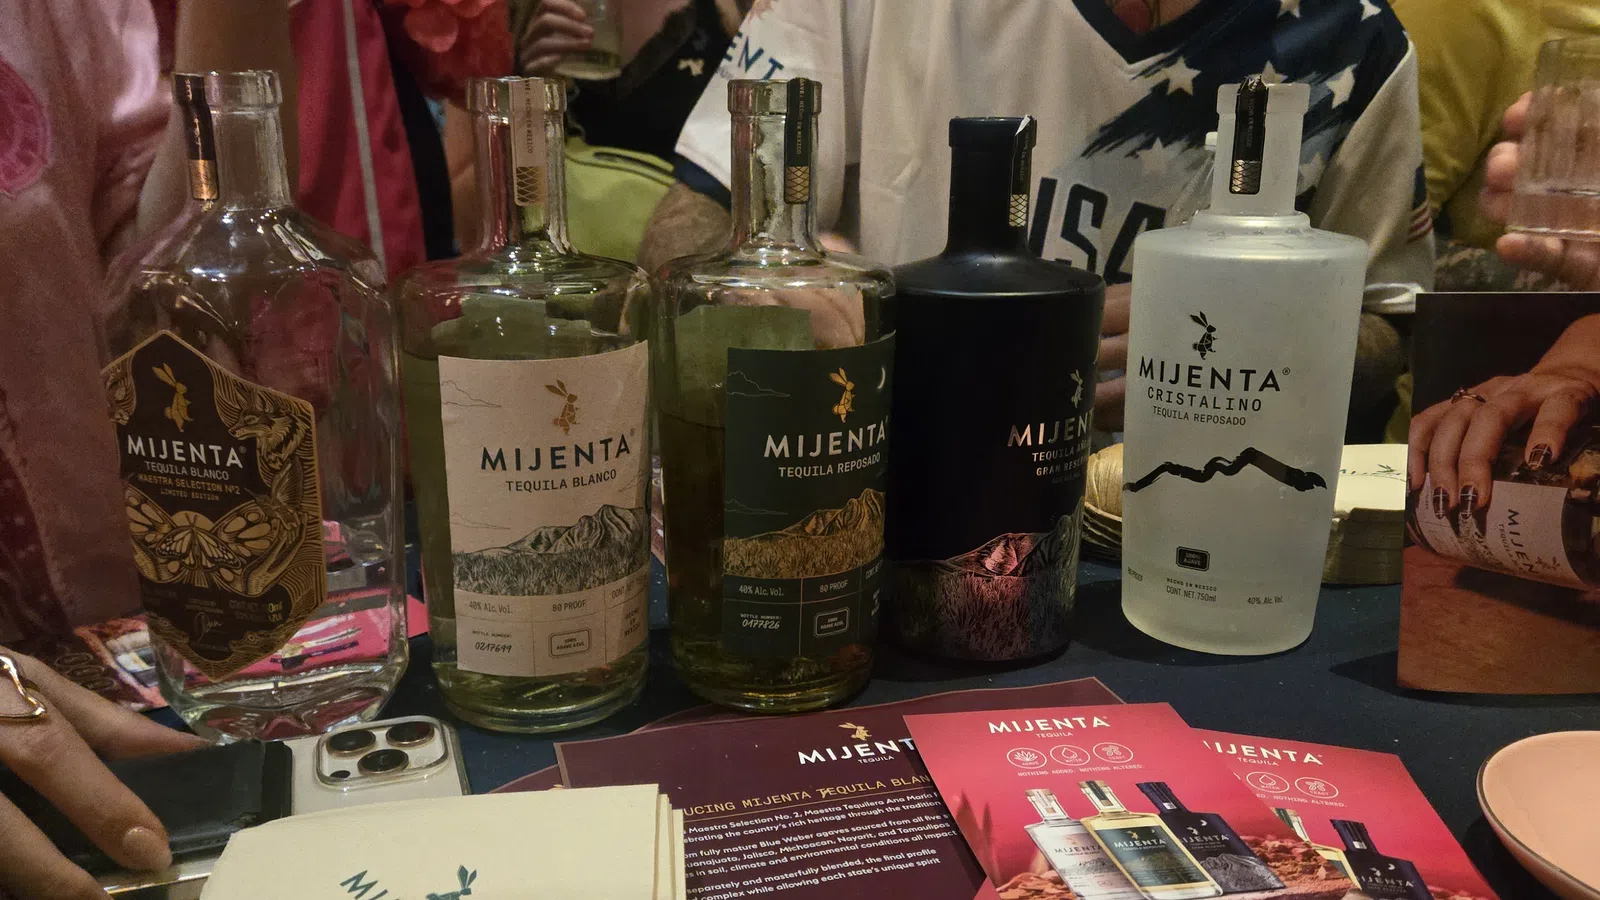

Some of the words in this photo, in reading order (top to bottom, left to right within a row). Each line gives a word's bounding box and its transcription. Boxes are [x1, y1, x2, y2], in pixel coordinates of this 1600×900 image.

[1148, 386, 1262, 412] CRISTALINO
[1153, 406, 1189, 420] TEQUILA
[1194, 414, 1246, 426] REPOSADO
[128, 434, 243, 468] MIJENTA
[764, 420, 886, 458] MIJENTA
[481, 434, 630, 471] MIJENTA
[778, 465, 834, 478] TEQUILA
[838, 452, 880, 473] REPOSADO
[1032, 446, 1074, 462] TEQUILA
[144, 461, 188, 476] TEQUILA
[190, 467, 229, 480] BLANCO
[506, 480, 568, 492] TEQUILA
[573, 468, 616, 487] BLANCO
[1036, 464, 1060, 476] GRAN
[175, 478, 223, 492] SELECTION
[1508, 509, 1540, 574] MIJEN
[820, 584, 828, 592] 80
[829, 580, 848, 591] PROOF
[552, 604, 562, 612] 80
[564, 600, 586, 611] PROOF
[988, 716, 1110, 734] MIJENTA
[798, 737, 914, 765] MIJENT
[858, 755, 895, 764] TEQUILA
[1203, 740, 1323, 765] IJENTA
[1237, 757, 1279, 766] TEQUILA
[741, 791, 812, 808] MIJENTA
[816, 780, 886, 797] TEQUILA
[890, 774, 930, 787] BLAN
[689, 824, 728, 834] Maestra
[730, 817, 773, 828] Selection
[804, 806, 842, 816] Maestra
[842, 800, 884, 811] Tequilera
[807, 813, 846, 825] heritage
[848, 808, 885, 818] through
[902, 800, 942, 810] tradition
[700, 849, 721, 857] fully
[723, 844, 758, 854] mature
[782, 833, 814, 843] Weber
[816, 828, 850, 839] agaves
[851, 821, 888, 832] sourced
[888, 818, 911, 827] from
[743, 851, 778, 860] Jalisco,
[780, 839, 836, 853] Michoacan,
[837, 833, 876, 843] Nayarit,
[898, 822, 951, 835] Tamaulipas
[1180, 834, 1230, 844] IJENTA
[708, 867, 728, 875] soil,
[730, 861, 767, 871] climate
[768, 857, 788, 865] and
[790, 844, 859, 861] environmental
[860, 837, 910, 849] conditions
[925, 830, 958, 840] impact
[687, 882, 740, 894] separately
[742, 877, 762, 886] and
[764, 867, 819, 882] masterfully
[820, 859, 864, 871] blended,
[883, 853, 905, 861] final
[906, 848, 937, 858] profile
[700, 890, 745, 900] complex
[747, 884, 774, 894] while
[776, 877, 819, 890] allowing
[821, 872, 846, 882] each
[881, 862, 915, 872] unique
[916, 858, 942, 867] spirit
[1357, 875, 1414, 887] IJENTA
